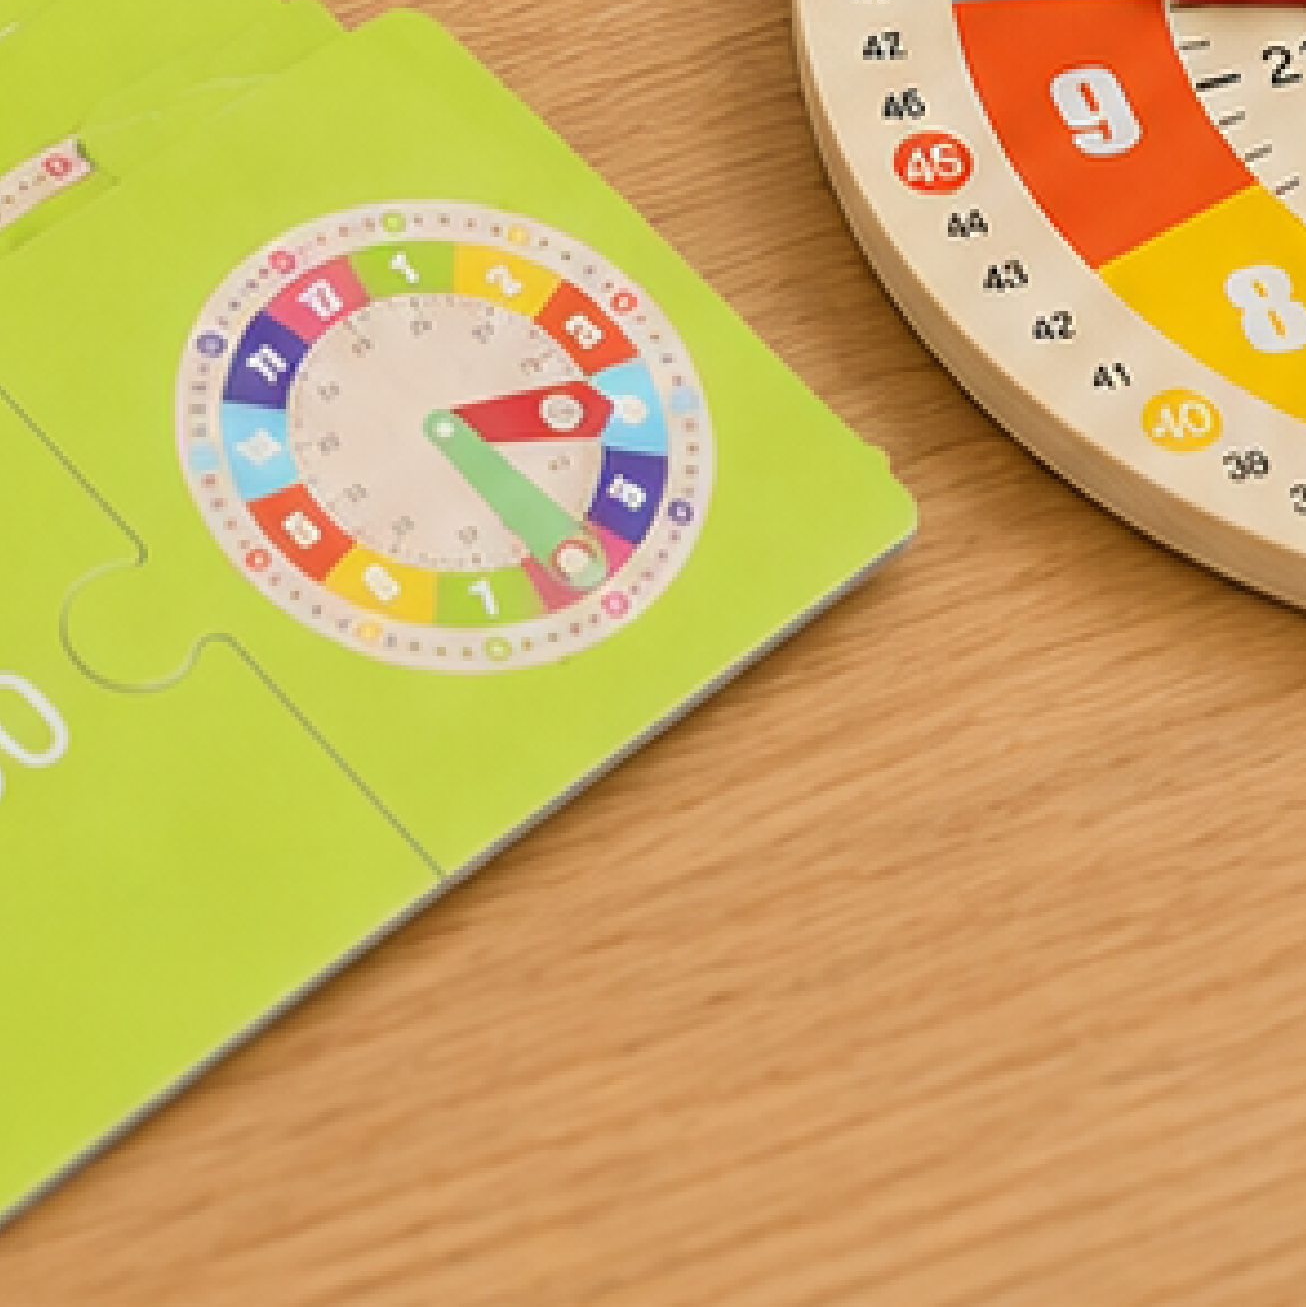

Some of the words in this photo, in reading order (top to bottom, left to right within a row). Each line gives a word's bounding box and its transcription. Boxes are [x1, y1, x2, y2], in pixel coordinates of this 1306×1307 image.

[1050, 69, 1139, 153] 9
[903, 144, 964, 184] 45
[1092, 361, 1132, 388] 41
